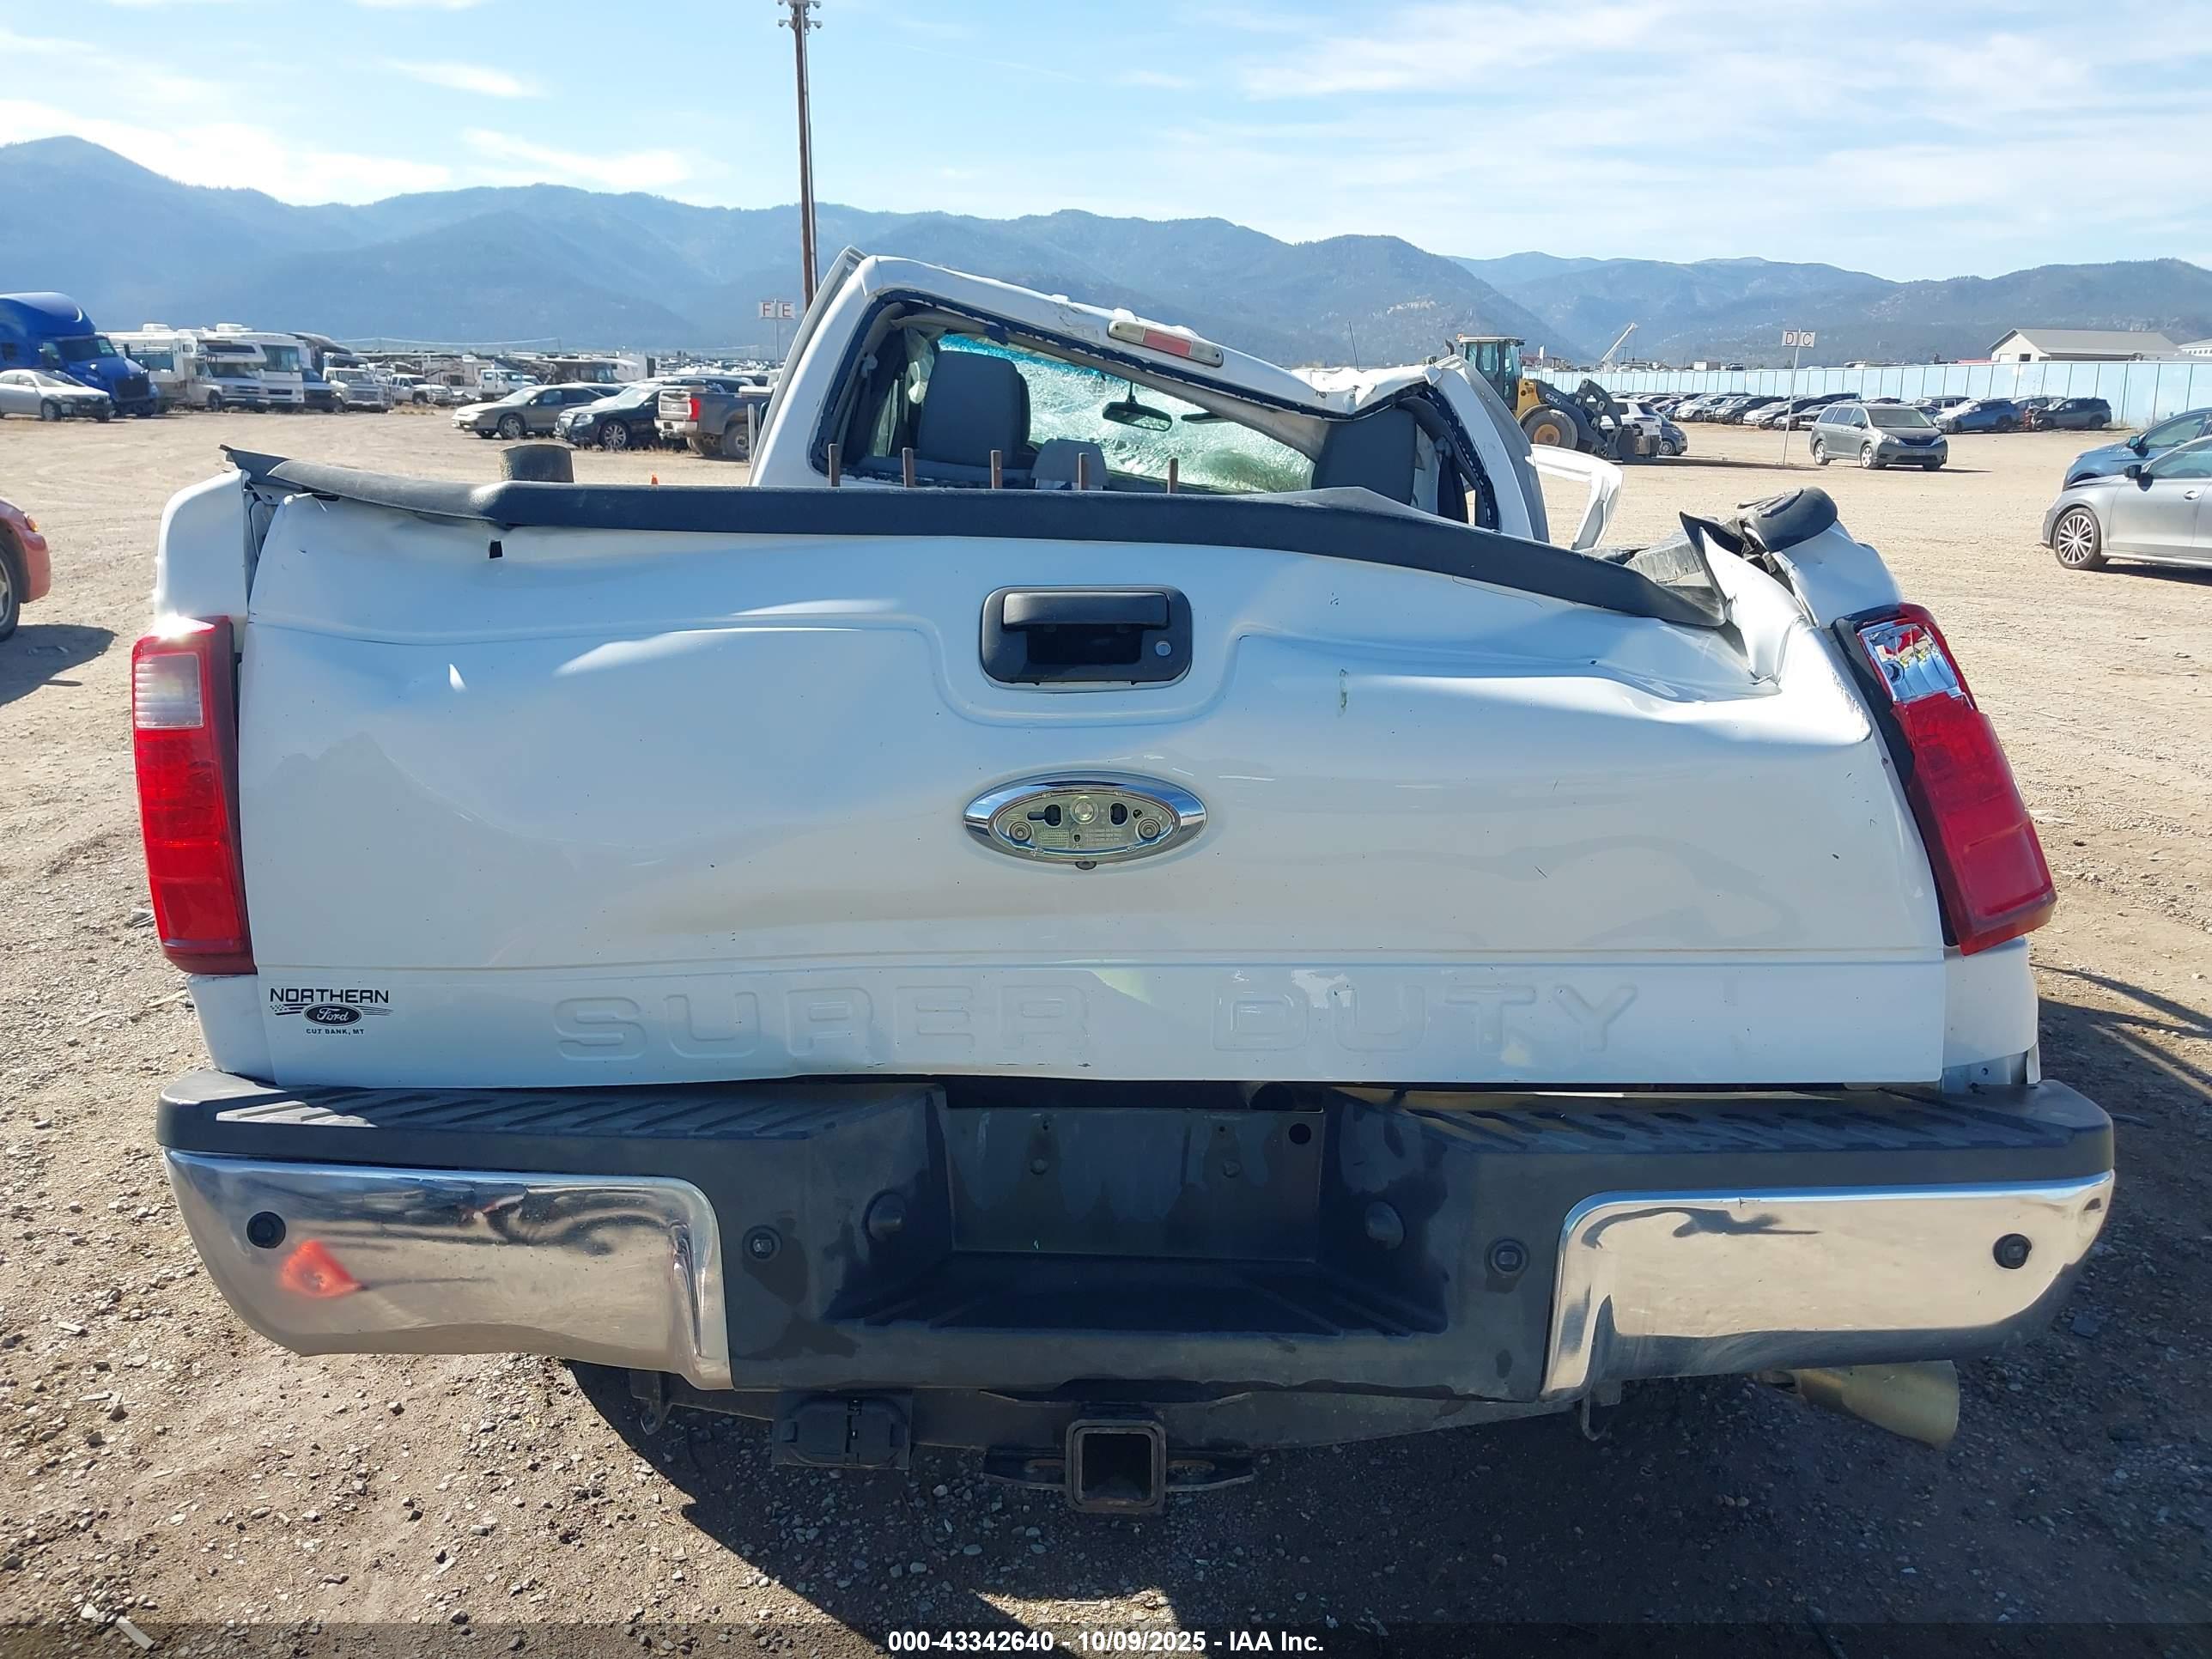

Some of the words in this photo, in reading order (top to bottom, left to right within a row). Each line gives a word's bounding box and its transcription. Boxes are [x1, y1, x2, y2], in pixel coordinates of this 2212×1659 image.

[763, 303, 771, 317] F
[782, 304, 792, 317] E
[1786, 332, 1794, 344] D
[1803, 333, 1811, 345] C
[270, 988, 389, 1003] NORTHERN
[316, 1007, 349, 1021] Ford
[554, 985, 1090, 1061] SUPER
[1212, 983, 1638, 1054] DUTY
